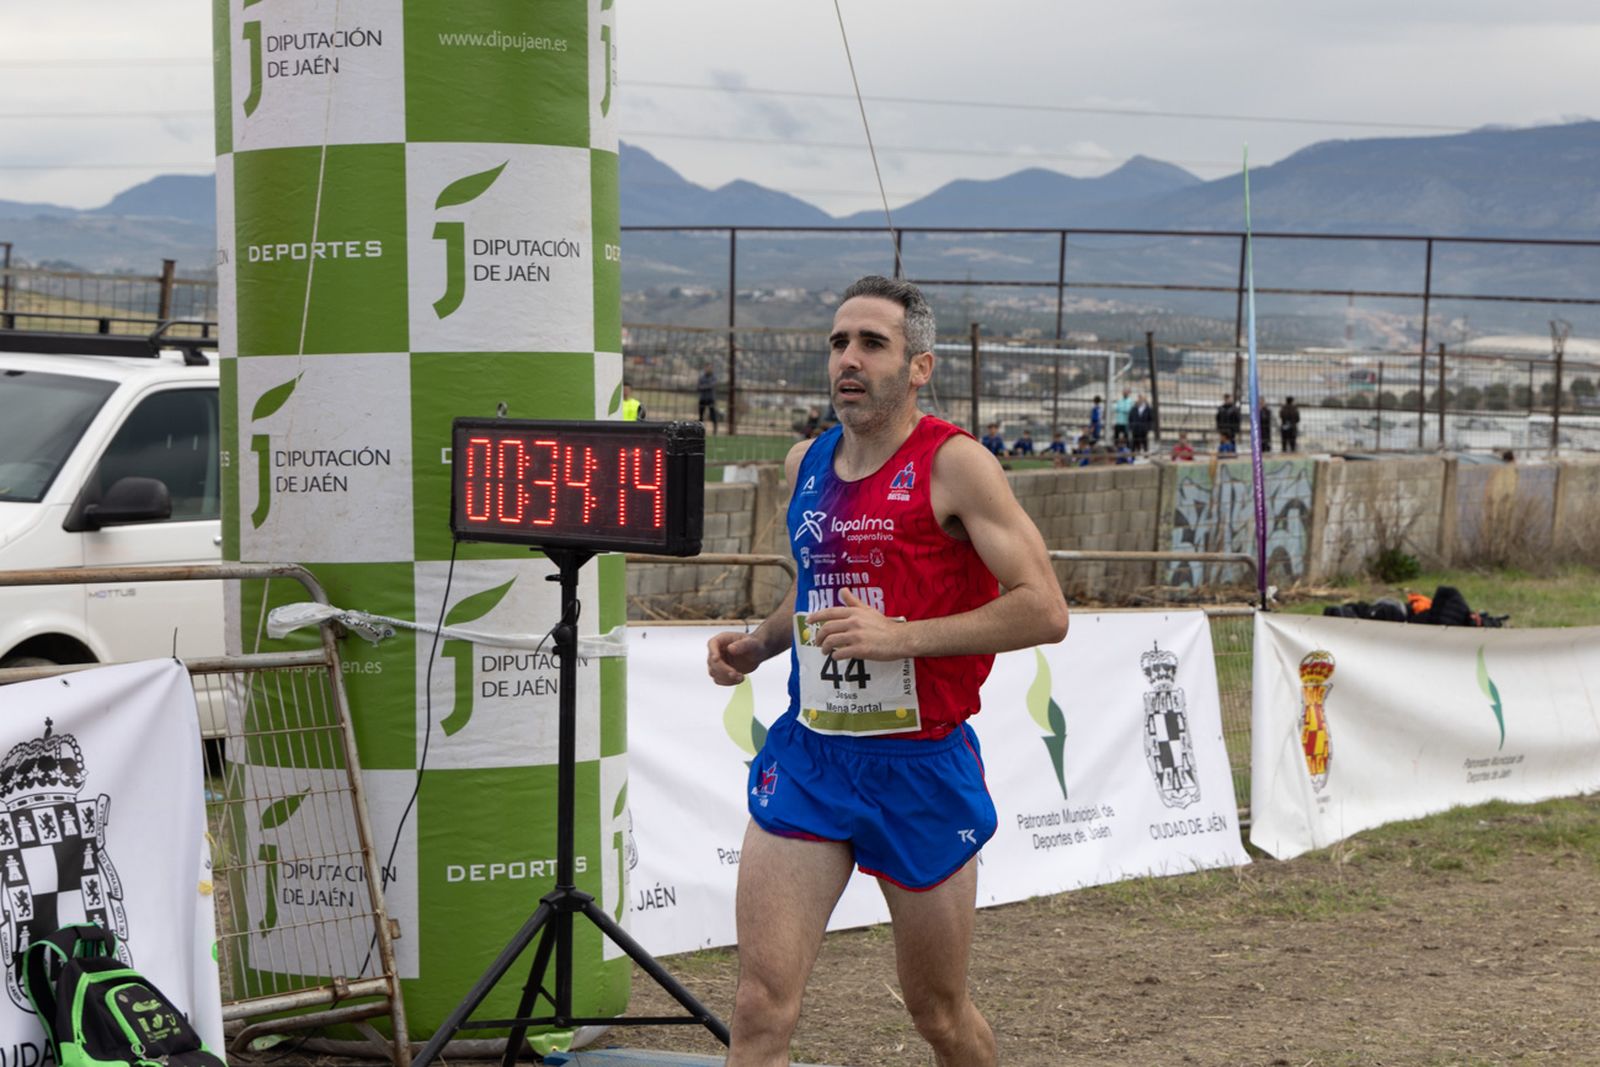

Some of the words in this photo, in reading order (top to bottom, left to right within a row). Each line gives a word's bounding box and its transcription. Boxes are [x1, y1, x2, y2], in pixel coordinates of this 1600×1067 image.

[267, 27, 382, 53] DIPUTACIÓN
[438, 30, 568, 53] www.dipujaen.es
[267, 61, 289, 78] DE
[292, 57, 339, 75] JAÉN
[249, 241, 382, 262] DEPORTES
[473, 237, 580, 258] DIPUTACIÓN
[474, 265, 500, 282] DE
[503, 262, 550, 282] JAÉN
[276, 445, 391, 468] DIPUTACIÓN
[276, 476, 299, 493] DE
[300, 473, 348, 493] JAÉN
[847, 531, 894, 544] cooperativa
[482, 653, 588, 672] DIPUTACN
[821, 648, 871, 690] 44
[482, 681, 509, 698] DE
[513, 676, 558, 697] JAÉN
[1016, 812, 1061, 830] Patronato
[1101, 803, 1116, 818] de
[1032, 831, 1073, 851] Deportes
[1074, 828, 1087, 844] de
[1149, 820, 1188, 841] CIUDAD
[1188, 817, 1206, 836] DE
[282, 861, 398, 882] DIPUTACIN
[447, 856, 587, 883] DEPORTS
[283, 888, 303, 906] DE
[307, 886, 355, 907] JAÉN
[637, 882, 676, 911] JAÉN
